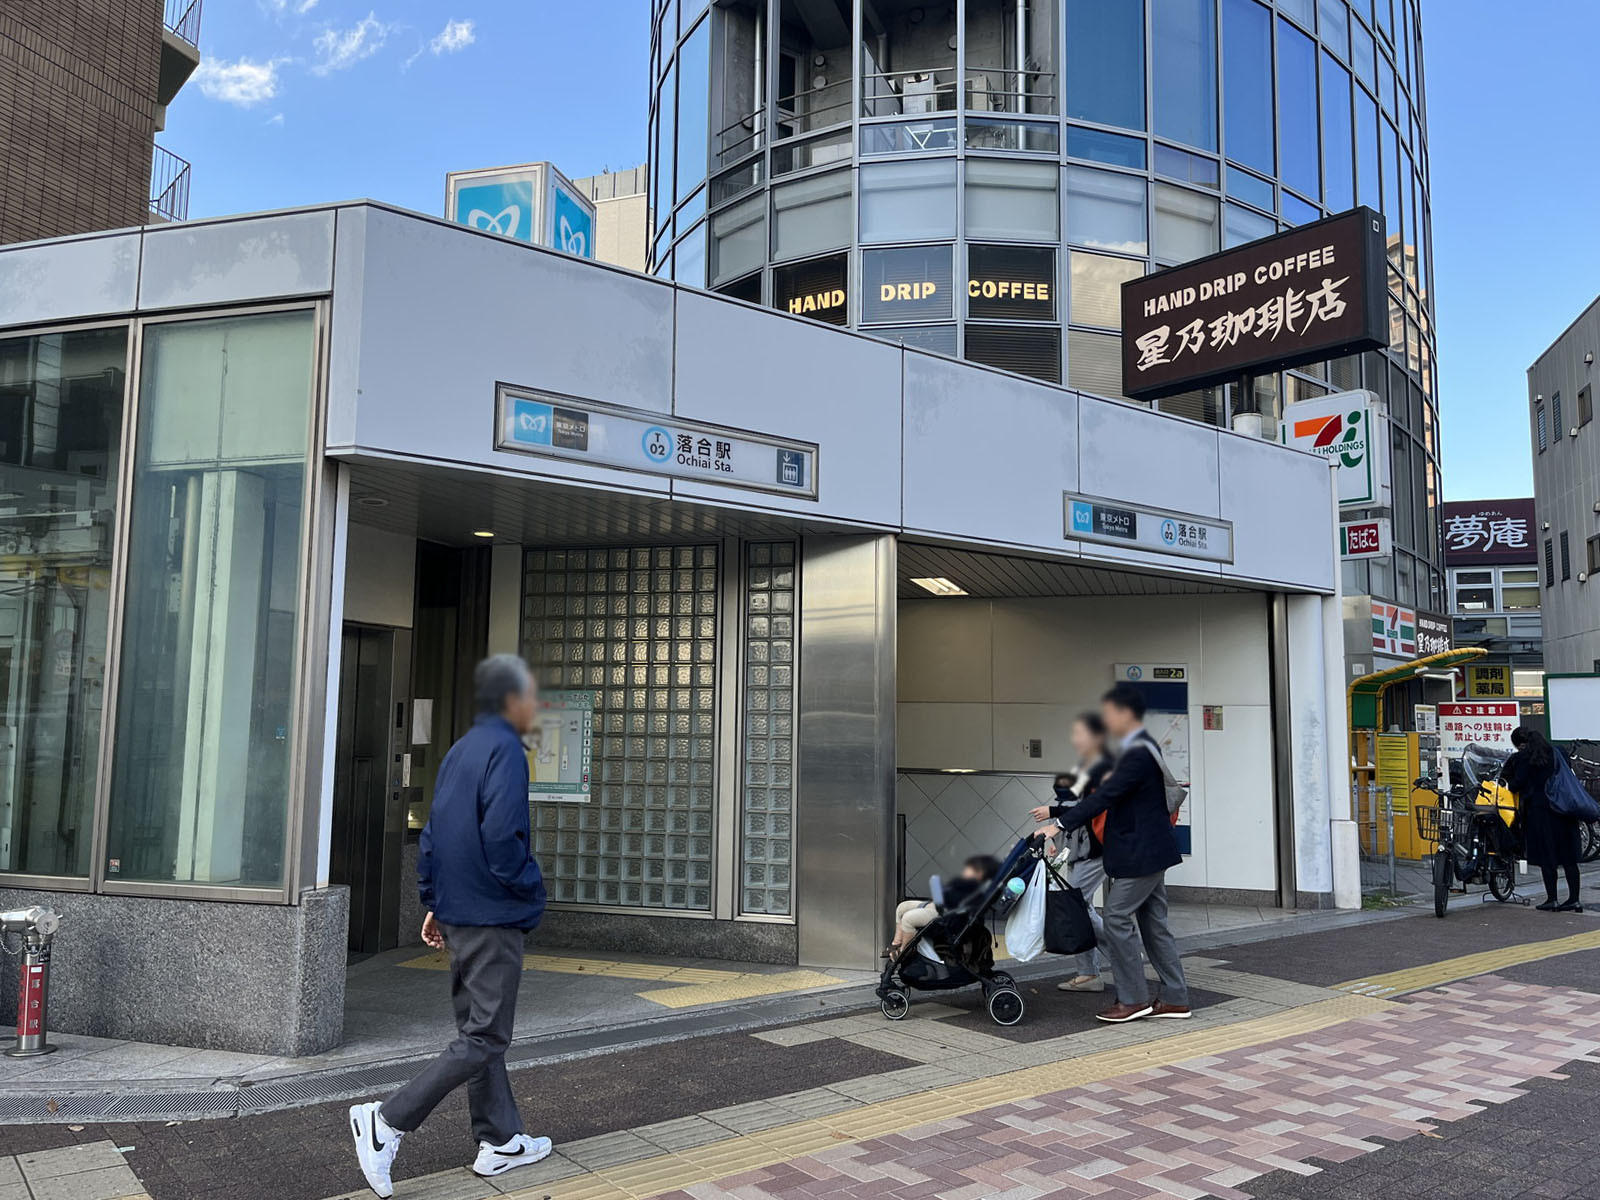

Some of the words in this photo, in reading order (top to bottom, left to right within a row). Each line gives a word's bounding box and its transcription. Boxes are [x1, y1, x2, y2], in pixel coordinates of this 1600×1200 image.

[1143, 286, 1196, 318] HAND
[1199, 271, 1247, 302] DRIP
[1253, 244, 1336, 285] COFFEE
[789, 289, 845, 314] HAND
[880, 281, 936, 301] DRIP
[968, 279, 1049, 301] COFFEE
[1134, 275, 1350, 372] 星乃珈琲店
[654, 432, 661, 443] T
[649, 443, 665, 456] 02
[676, 434, 731, 461] 落合駅
[1322, 440, 1365, 456] HOLDINGS
[676, 453, 711, 470] Ochiai
[713, 459, 734, 473] Sta.
[1100, 512, 1130, 526] 東京メトロ
[1166, 523, 1171, 531] T
[1178, 523, 1207, 541] 落合駅
[1444, 514, 1528, 552] 夢庵
[1164, 531, 1173, 541] 02
[1178, 537, 1197, 548] Ochiai
[1349, 529, 1378, 550] たばこ
[1169, 668, 1183, 678] 2a
[1475, 667, 1504, 680] 調剤
[1475, 682, 1505, 695] 薬局
[1454, 732, 1505, 742] 禁止します。
